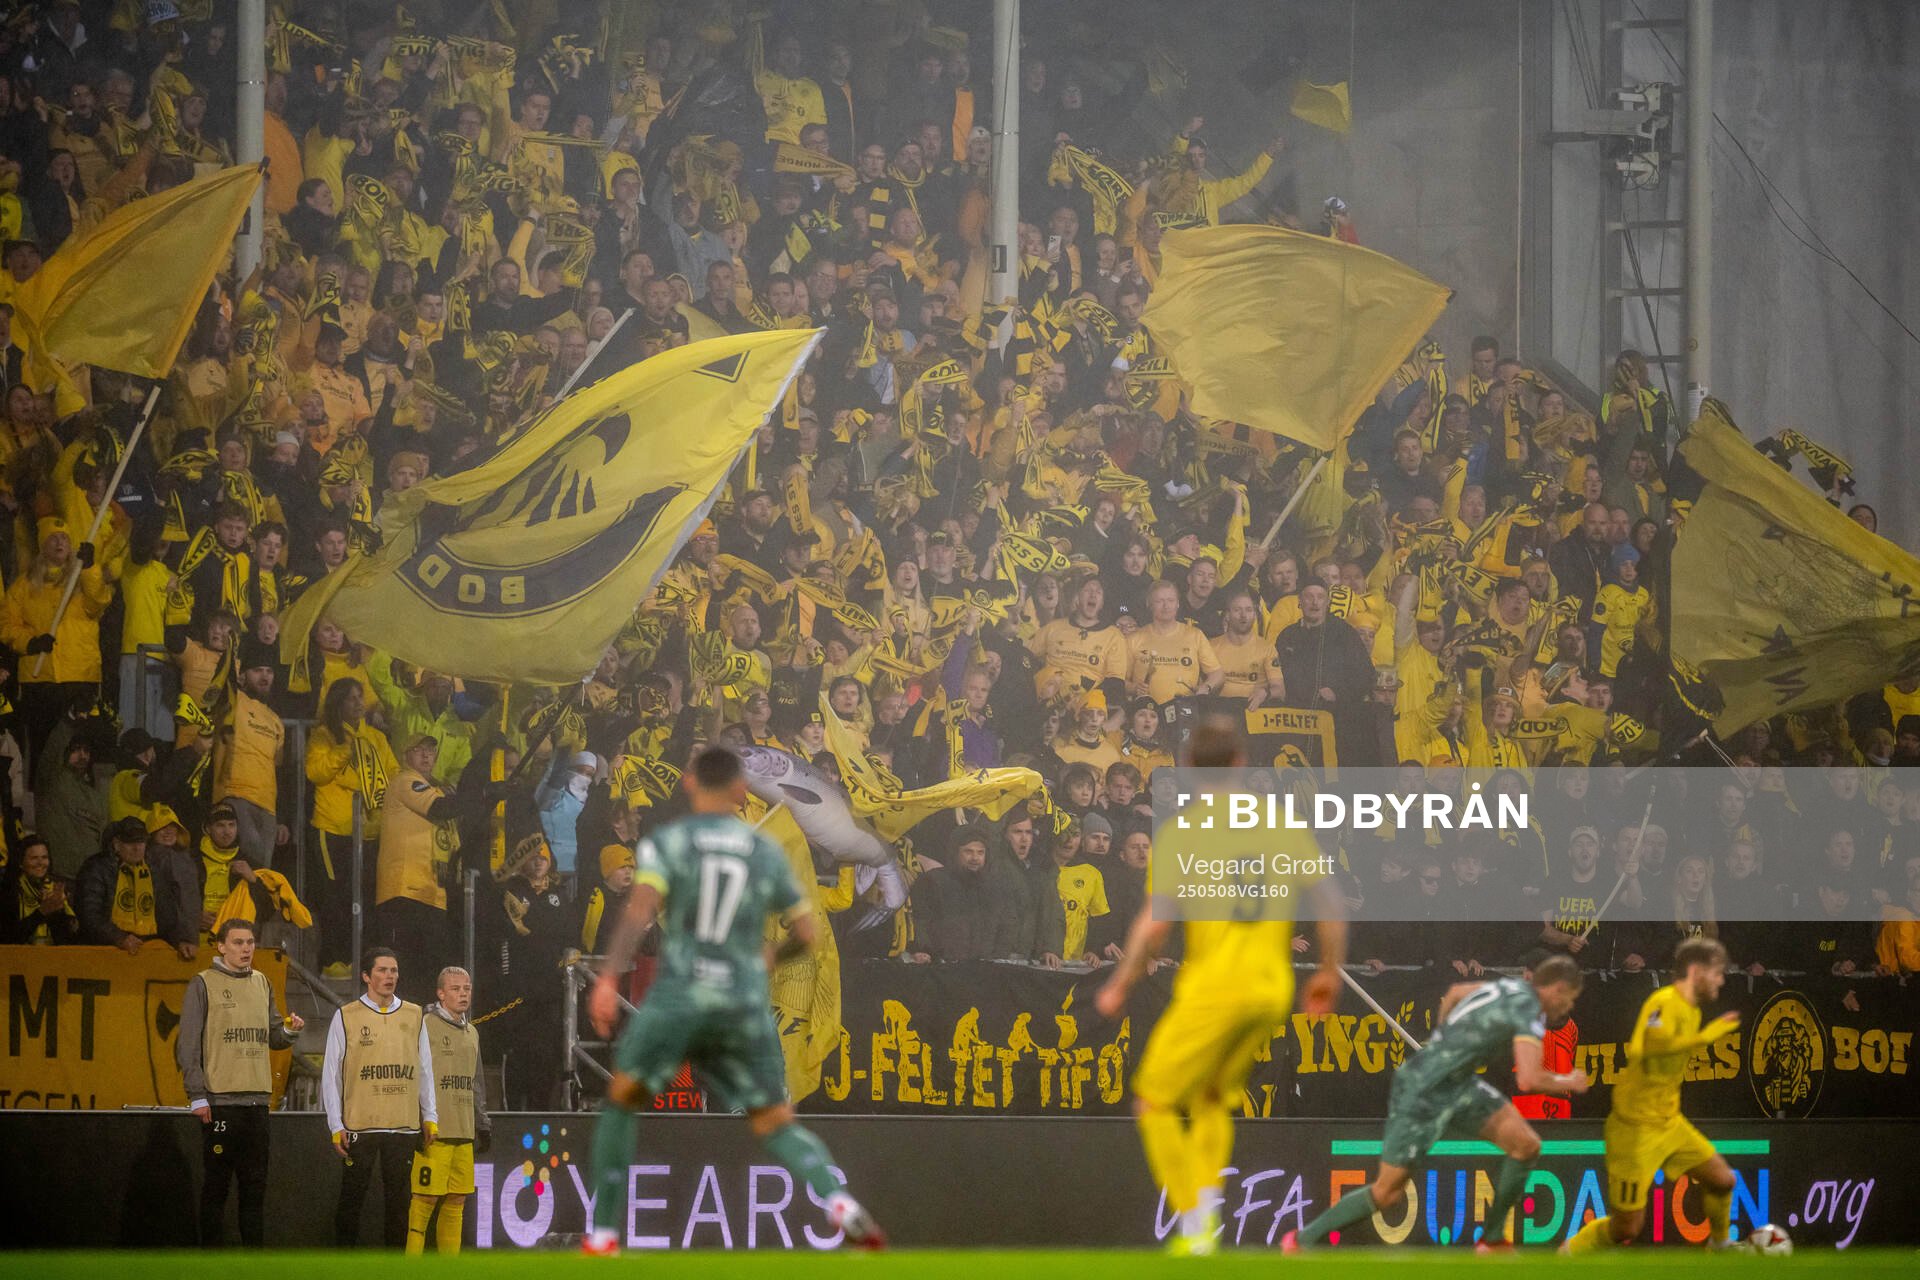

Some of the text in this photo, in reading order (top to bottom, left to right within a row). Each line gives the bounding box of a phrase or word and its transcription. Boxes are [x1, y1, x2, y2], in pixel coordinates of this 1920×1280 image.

[698, 853, 748, 946] 17
[1559, 896, 1597, 914] UEFA
[1554, 914, 1599, 933] MAFIA
[360, 1064, 415, 1080] #FOOTBALL
[214, 1121, 227, 1132] 25
[419, 1165, 431, 1187] 8
[1621, 1181, 1638, 1205] 11
[471, 1163, 847, 1250] 10 YEARS
